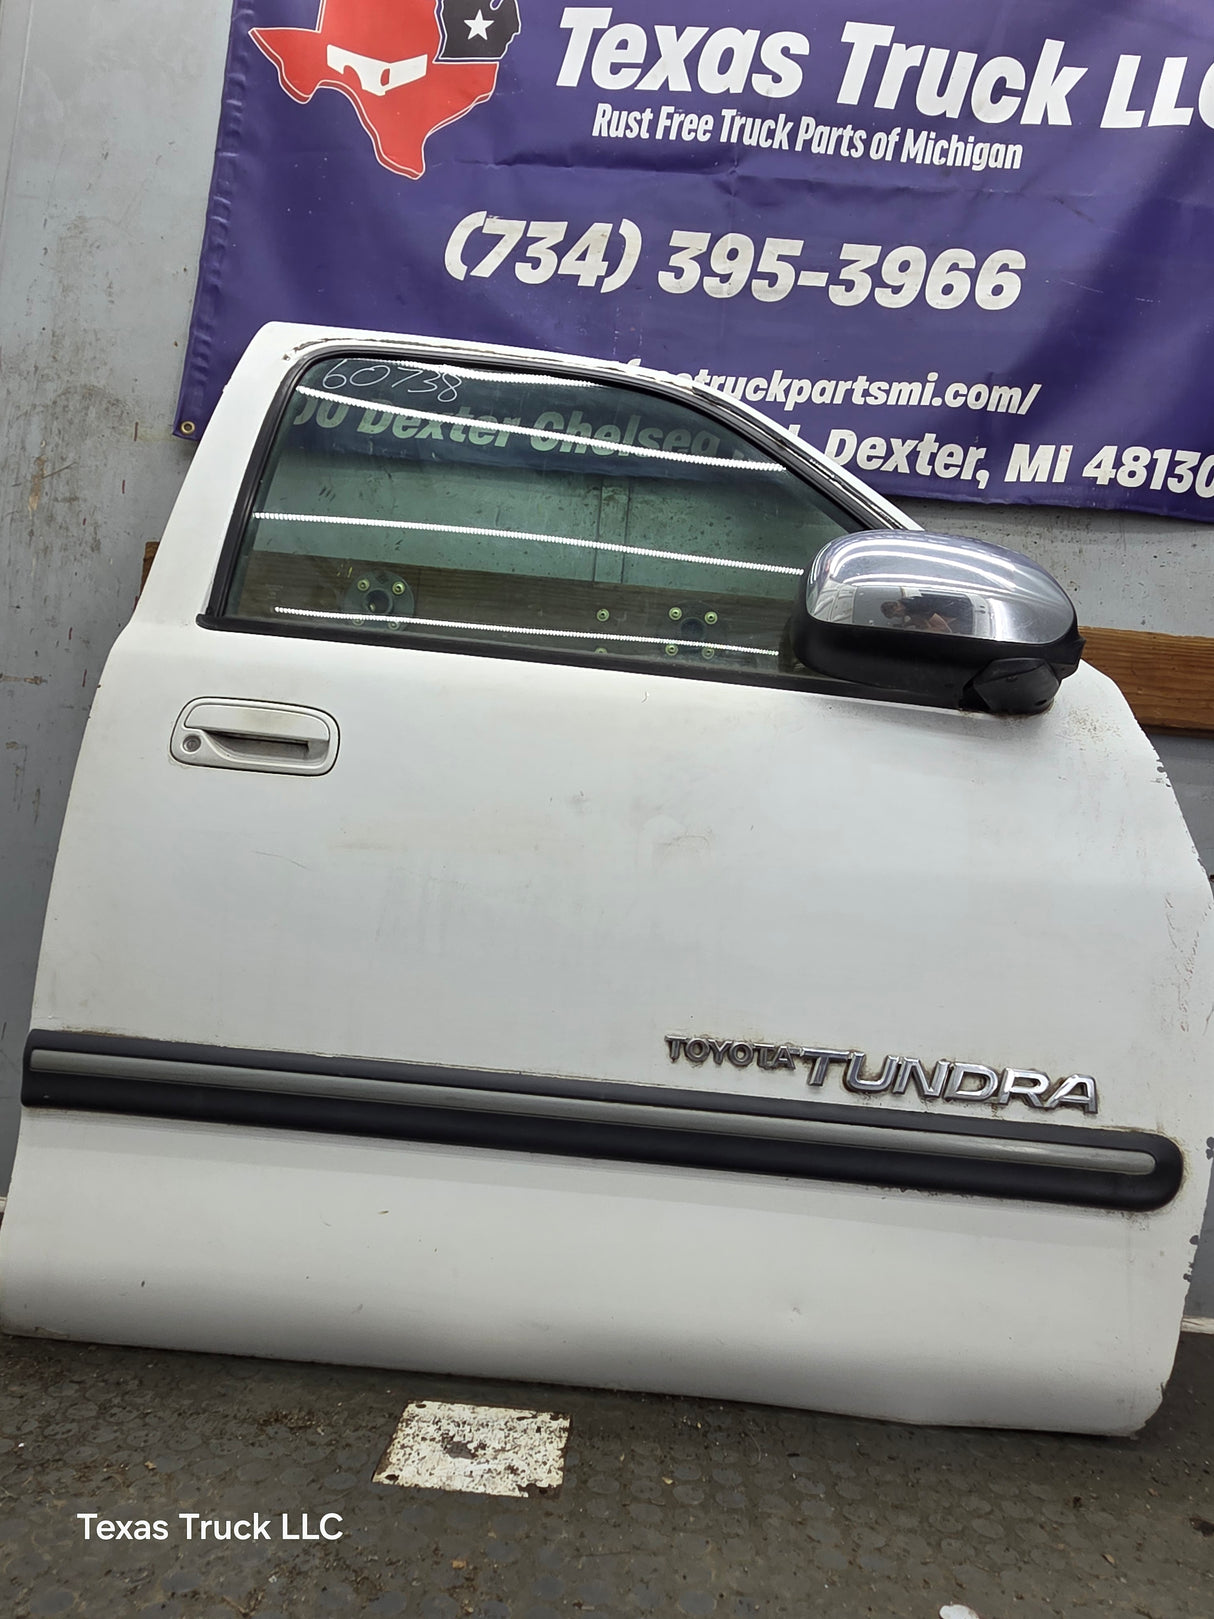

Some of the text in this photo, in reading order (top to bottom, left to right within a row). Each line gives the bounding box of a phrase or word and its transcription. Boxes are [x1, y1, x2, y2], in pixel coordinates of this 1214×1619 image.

[555, 7, 810, 99] Texas
[836, 21, 1088, 125] Truck
[592, 103, 1023, 171] Rust Free Truck Parts of Michigan
[444, 211, 1026, 310] (734) 395-3966
[322, 359, 462, 402] 60738
[826, 429, 990, 489] Dexter,
[1004, 443, 1073, 483] MI
[1082, 445, 1214, 498] 48130
[664, 1034, 1099, 1114] TOYOTA TUNDRA
